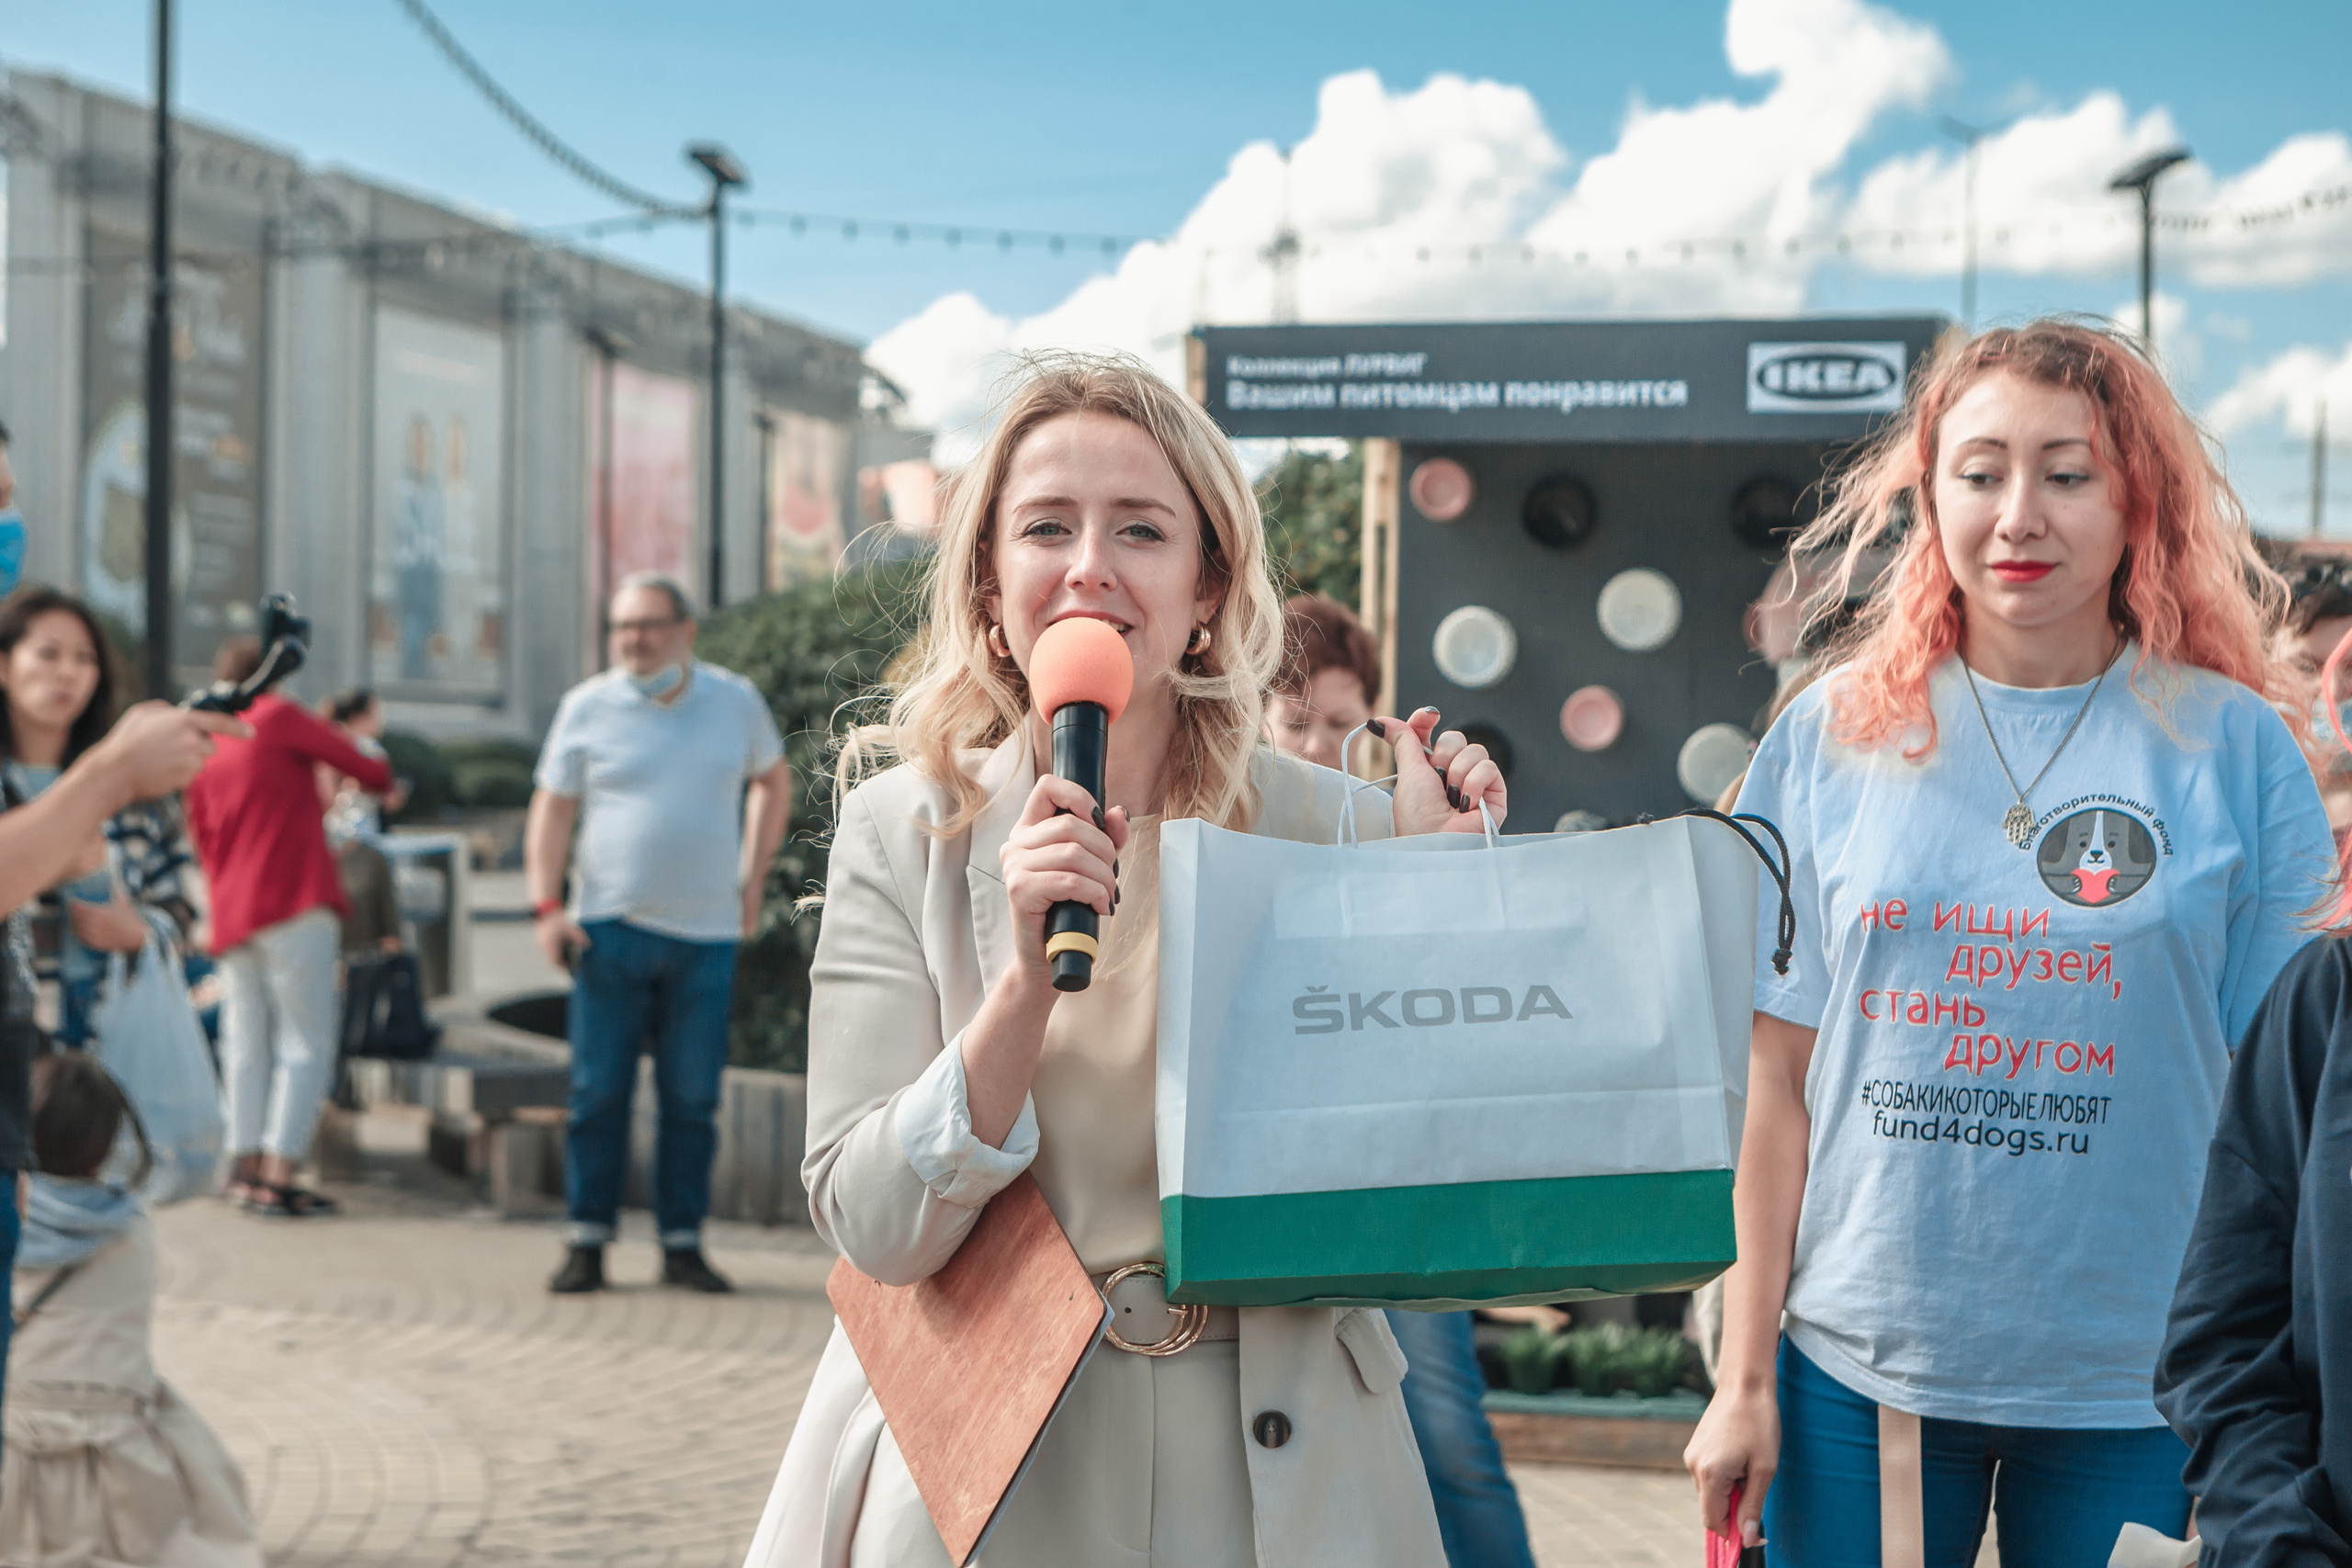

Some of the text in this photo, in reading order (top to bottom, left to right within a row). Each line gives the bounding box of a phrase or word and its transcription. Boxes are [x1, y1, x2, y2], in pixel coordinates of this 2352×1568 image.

[1227, 380, 1689, 413] Вашим питомцам понравится
[1764, 359, 1893, 393] IKEA
[2152, 818, 2174, 857] фонд
[1860, 898, 2051, 943] не ищи
[1945, 942, 2122, 1000] друзей,
[1292, 985, 1574, 1035] ŠKODA
[1860, 988, 1987, 1028] стань
[1943, 1033, 2115, 1080] другом
[1873, 1110, 2089, 1156] fund4dogs.ru
